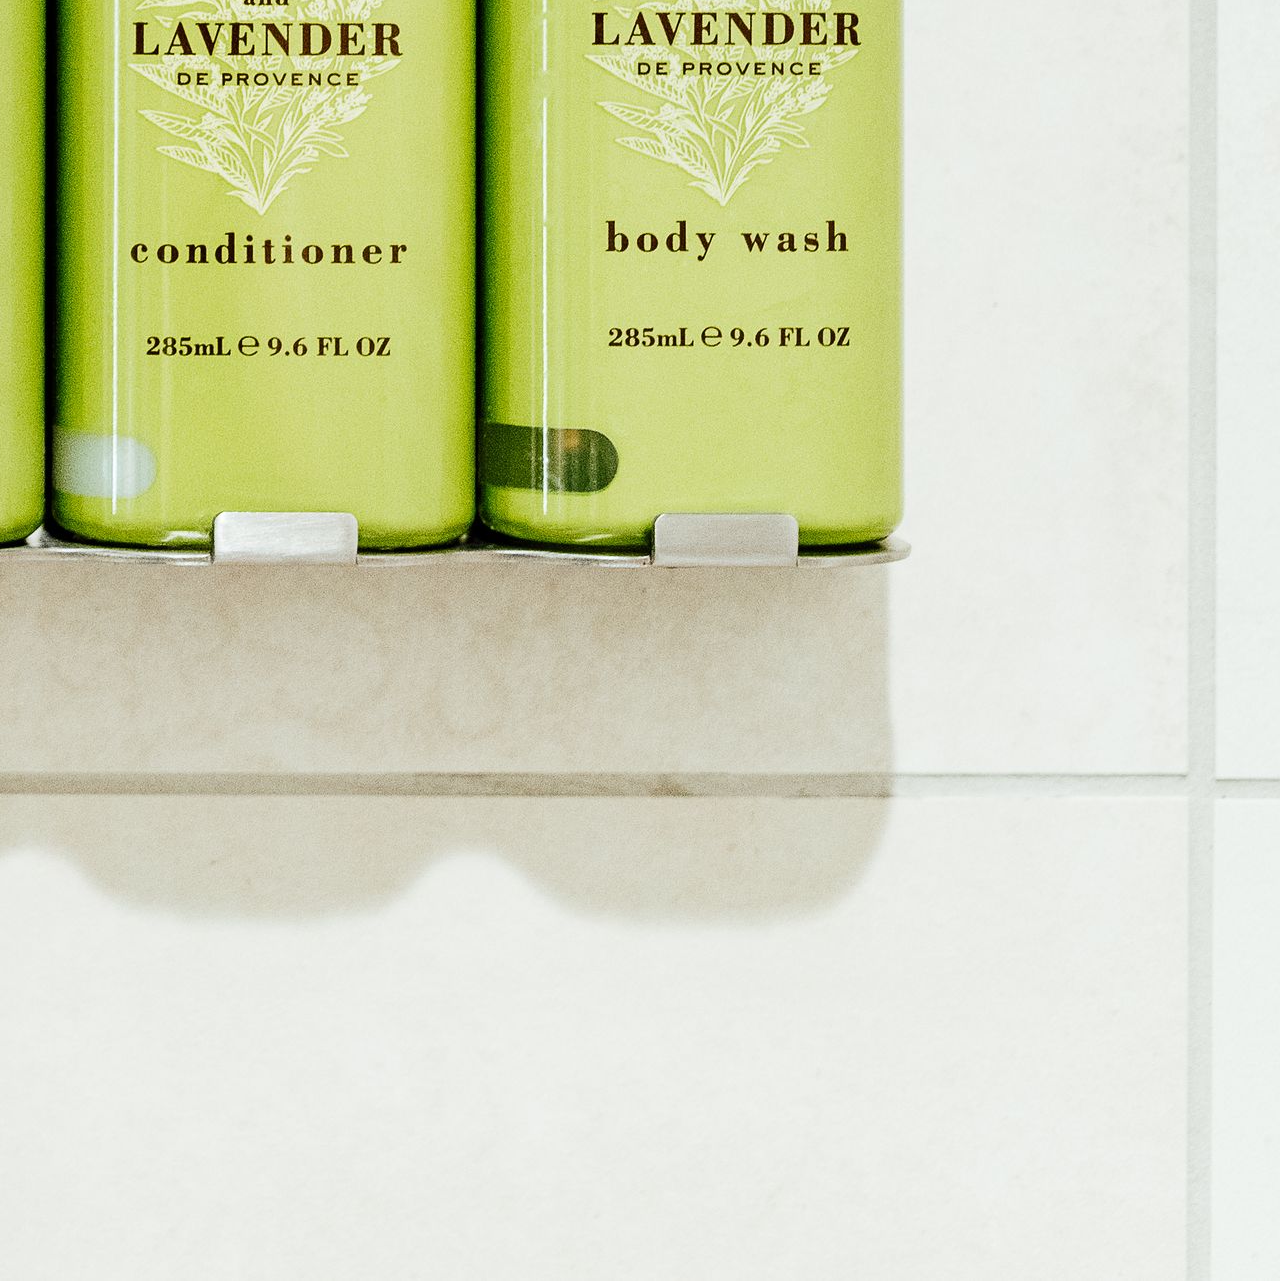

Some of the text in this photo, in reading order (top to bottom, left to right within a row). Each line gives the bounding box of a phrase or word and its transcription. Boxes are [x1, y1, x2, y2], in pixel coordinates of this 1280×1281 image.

[132, 21, 403, 57] LAVENDER
[591, 11, 862, 47] LAVENDER
[177, 72, 359, 87] DE PROVENCE
[637, 61, 821, 76] DE PROVENCE
[130, 231, 408, 265] conditioner
[605, 220, 849, 262] body wash
[146, 336, 232, 357] 285mL
[267, 336, 308, 357] 9.6
[317, 336, 349, 357] FL
[355, 336, 391, 357] OZ
[608, 327, 695, 347] 285mL
[730, 327, 770, 348] 9.6
[778, 327, 811, 347] FL
[817, 326, 850, 347] OZ
